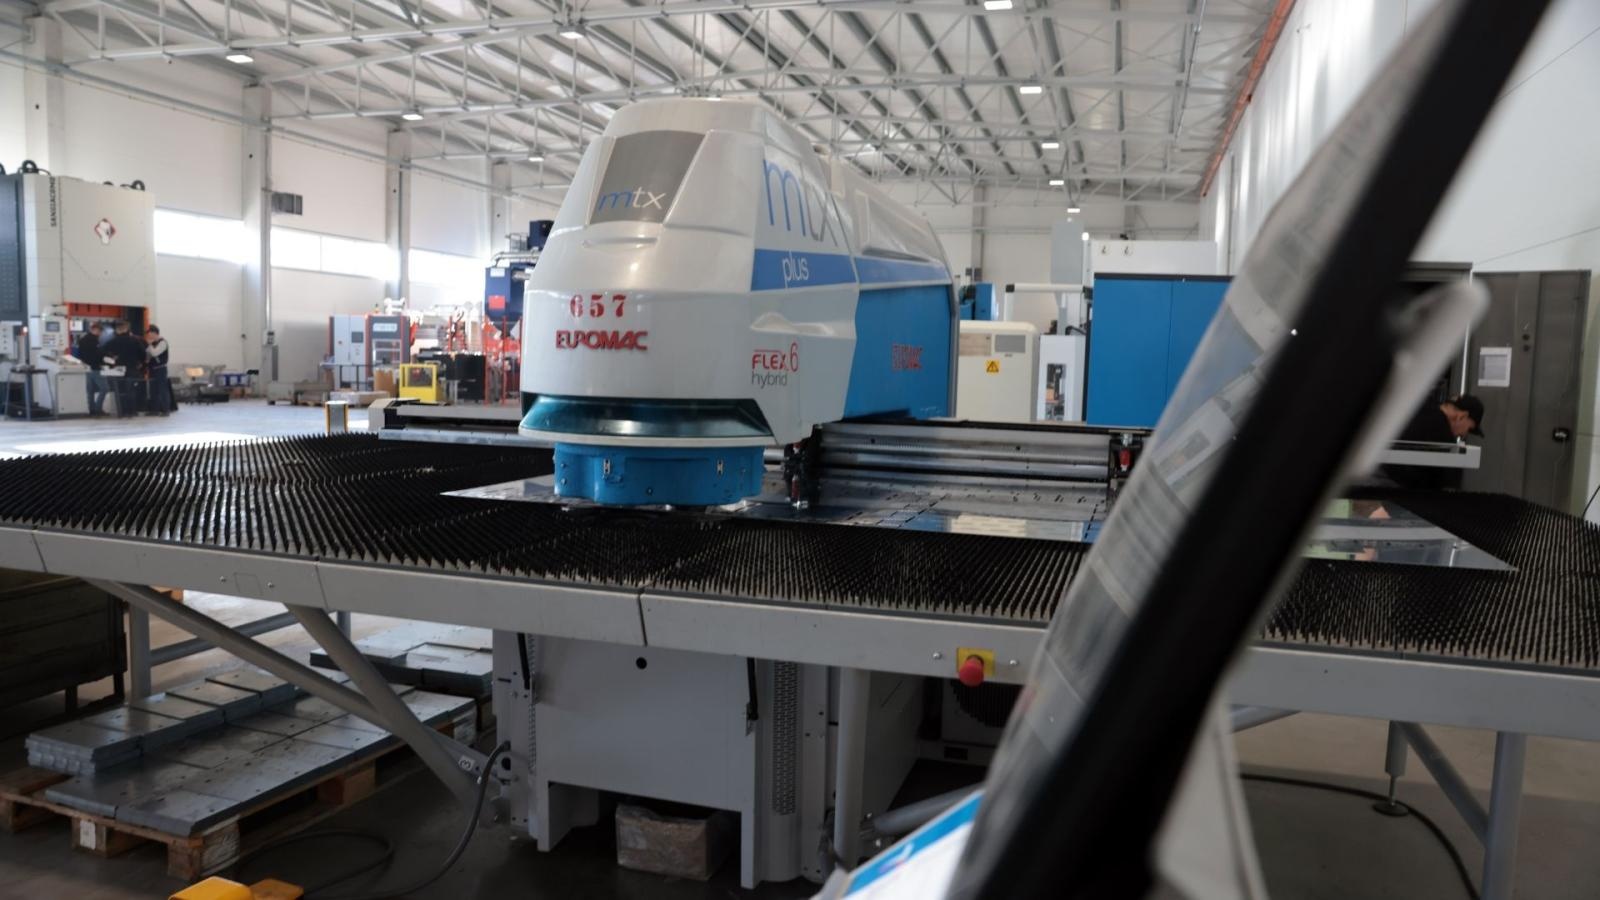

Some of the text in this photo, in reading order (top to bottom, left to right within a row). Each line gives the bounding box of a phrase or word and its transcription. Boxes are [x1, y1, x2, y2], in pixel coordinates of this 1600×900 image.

[599, 186, 666, 210] mtx
[782, 249, 809, 288] plus
[569, 294, 626, 317] 657
[556, 330, 648, 350] EUROMAC
[751, 370, 788, 389] hybrid
